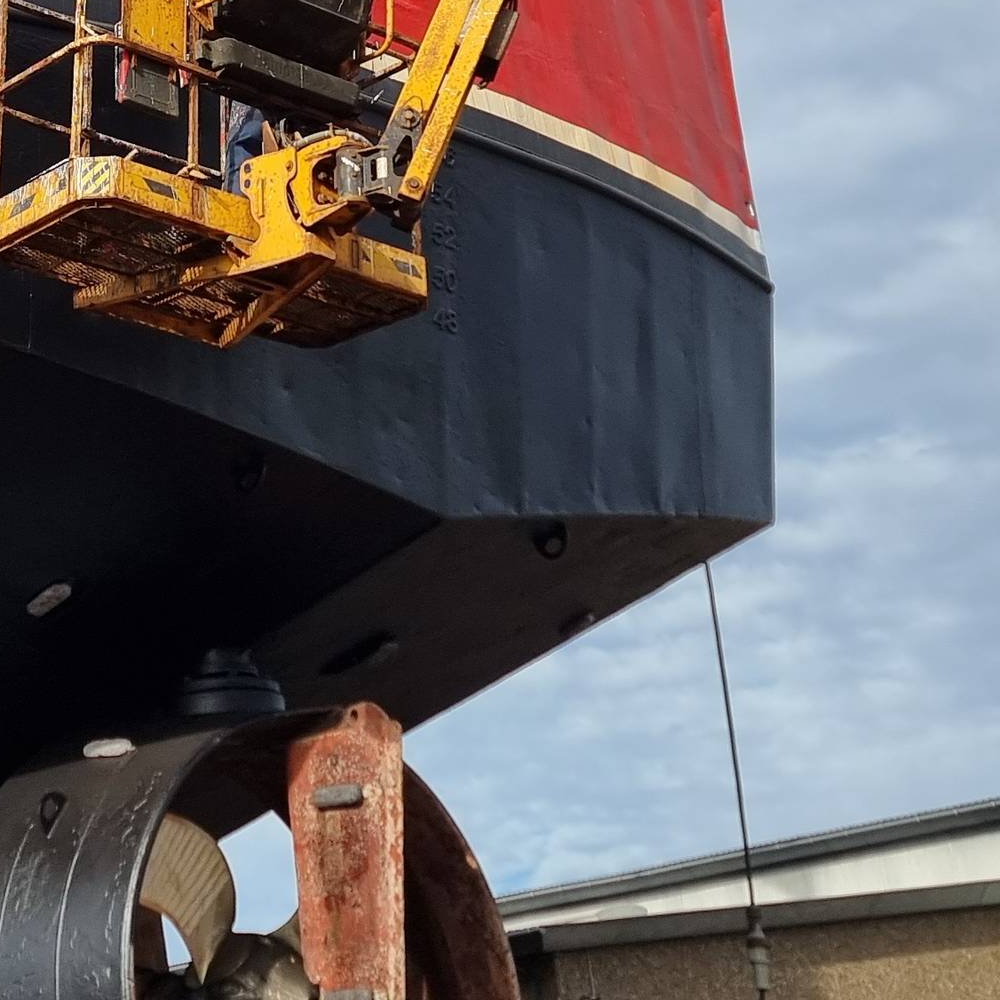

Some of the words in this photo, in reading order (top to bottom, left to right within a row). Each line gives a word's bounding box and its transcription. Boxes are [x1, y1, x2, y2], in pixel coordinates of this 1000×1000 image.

[431, 221, 457, 250] 52
[431, 264, 458, 293] 50
[432, 308, 458, 335] 48
